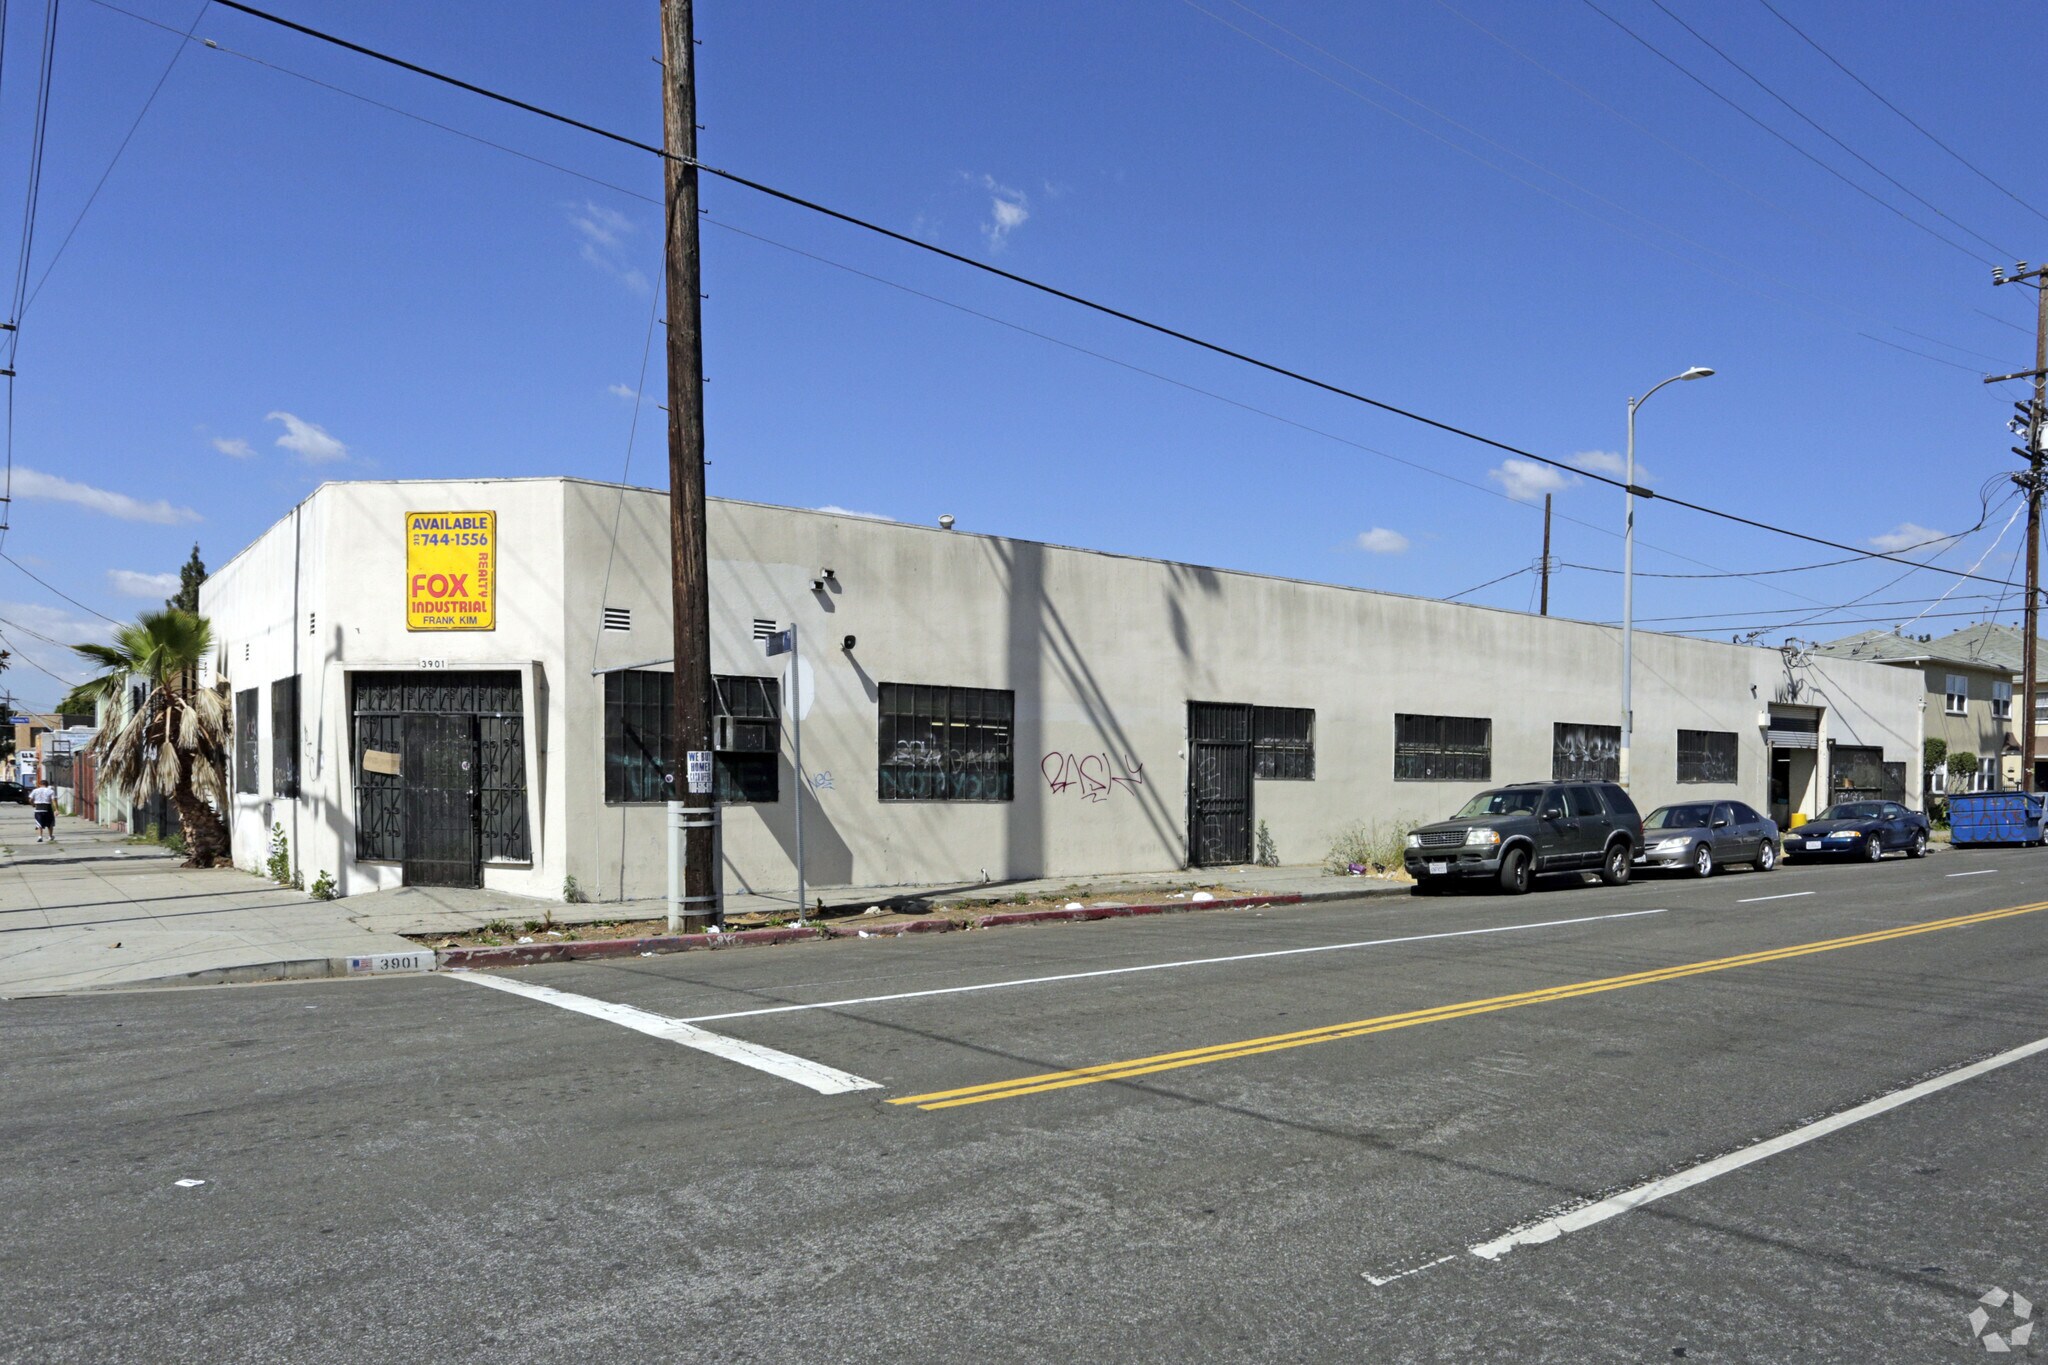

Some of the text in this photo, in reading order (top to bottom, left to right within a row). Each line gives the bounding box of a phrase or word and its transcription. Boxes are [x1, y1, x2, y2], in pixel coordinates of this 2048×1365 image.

[412, 517, 488, 530] AVAILABLE
[421, 533, 488, 546] 744-1556
[478, 552, 488, 598] REALTY
[412, 573, 469, 598] FOX
[412, 601, 487, 613] INDUSTRIAL
[423, 616, 478, 625] FRANK KIM
[421, 660, 445, 668] 3901
[689, 752, 699, 761] WE
[380, 957, 418, 970] 3901
